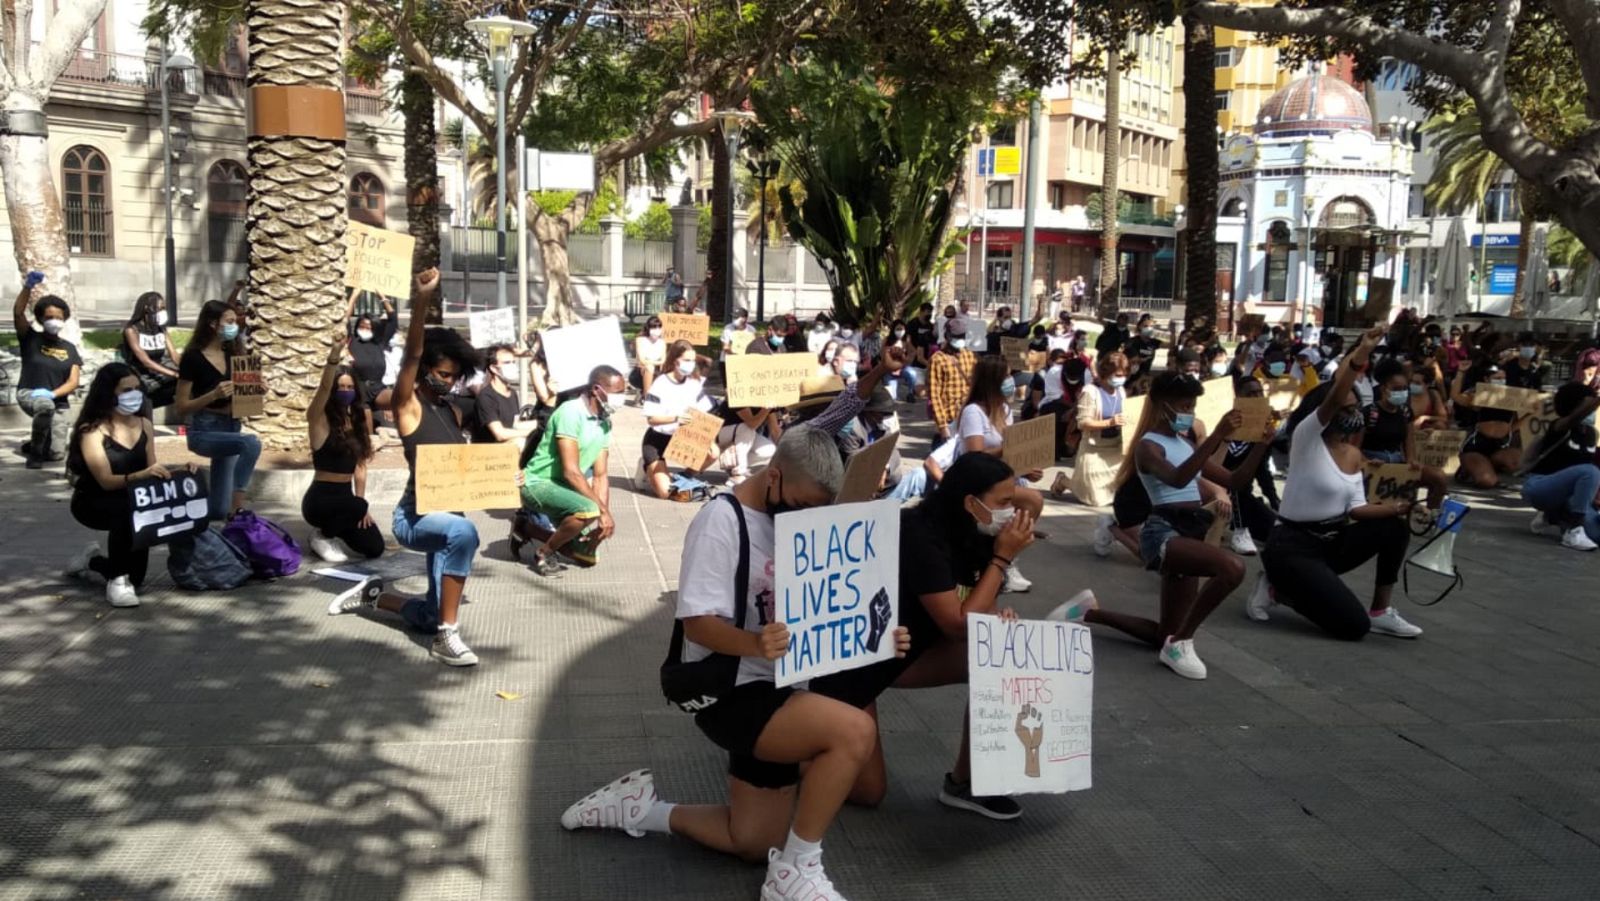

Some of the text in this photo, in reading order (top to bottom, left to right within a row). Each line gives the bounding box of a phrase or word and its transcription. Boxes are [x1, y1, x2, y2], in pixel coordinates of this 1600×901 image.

[346, 229, 386, 249] STOP
[354, 250, 391, 269] POLICE
[664, 330, 703, 339] NO PEACE
[729, 386, 745, 399] NO
[750, 384, 780, 397] PUEDO
[134, 480, 177, 507] BLM
[794, 520, 876, 577] BLACK
[785, 569, 861, 624] LIVES
[779, 615, 867, 677] MATTER
[977, 621, 1093, 675] BLACK LIVES
[680, 695, 718, 712] FILA
[1001, 677, 1054, 705] MATERS
